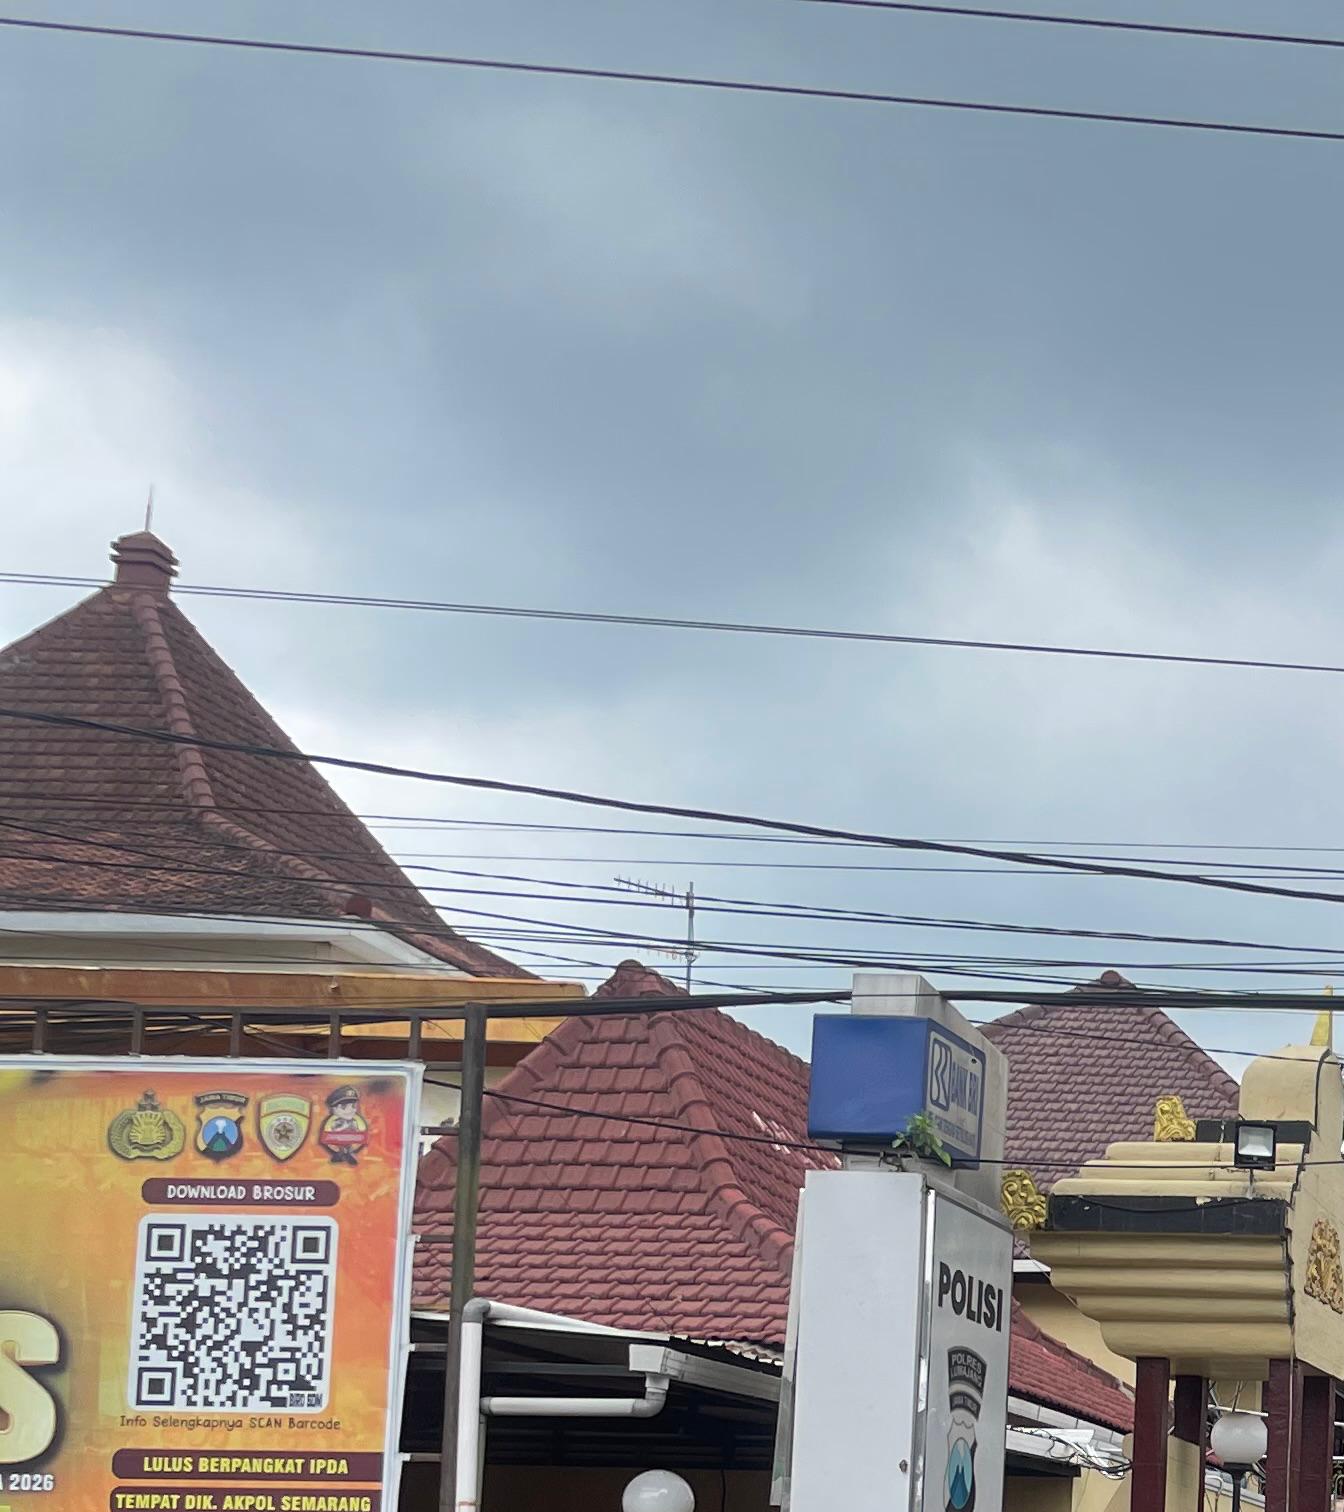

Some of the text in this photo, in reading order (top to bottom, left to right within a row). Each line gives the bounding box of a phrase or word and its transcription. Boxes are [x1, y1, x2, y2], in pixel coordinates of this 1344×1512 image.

[167, 1185, 316, 1201] DOWNLOAD BROSUR
[939, 1261, 1002, 1332] POLISI
[120, 1416, 341, 1431] Info Selengkapnya SCAN Barcode
[144, 1456, 348, 1474] LULUS BERPANGKAT IPDA
[10, 1474, 54, 1491] 2026
[116, 1494, 371, 1512] TEMPAT DIK. AKPOL SEMARANG
